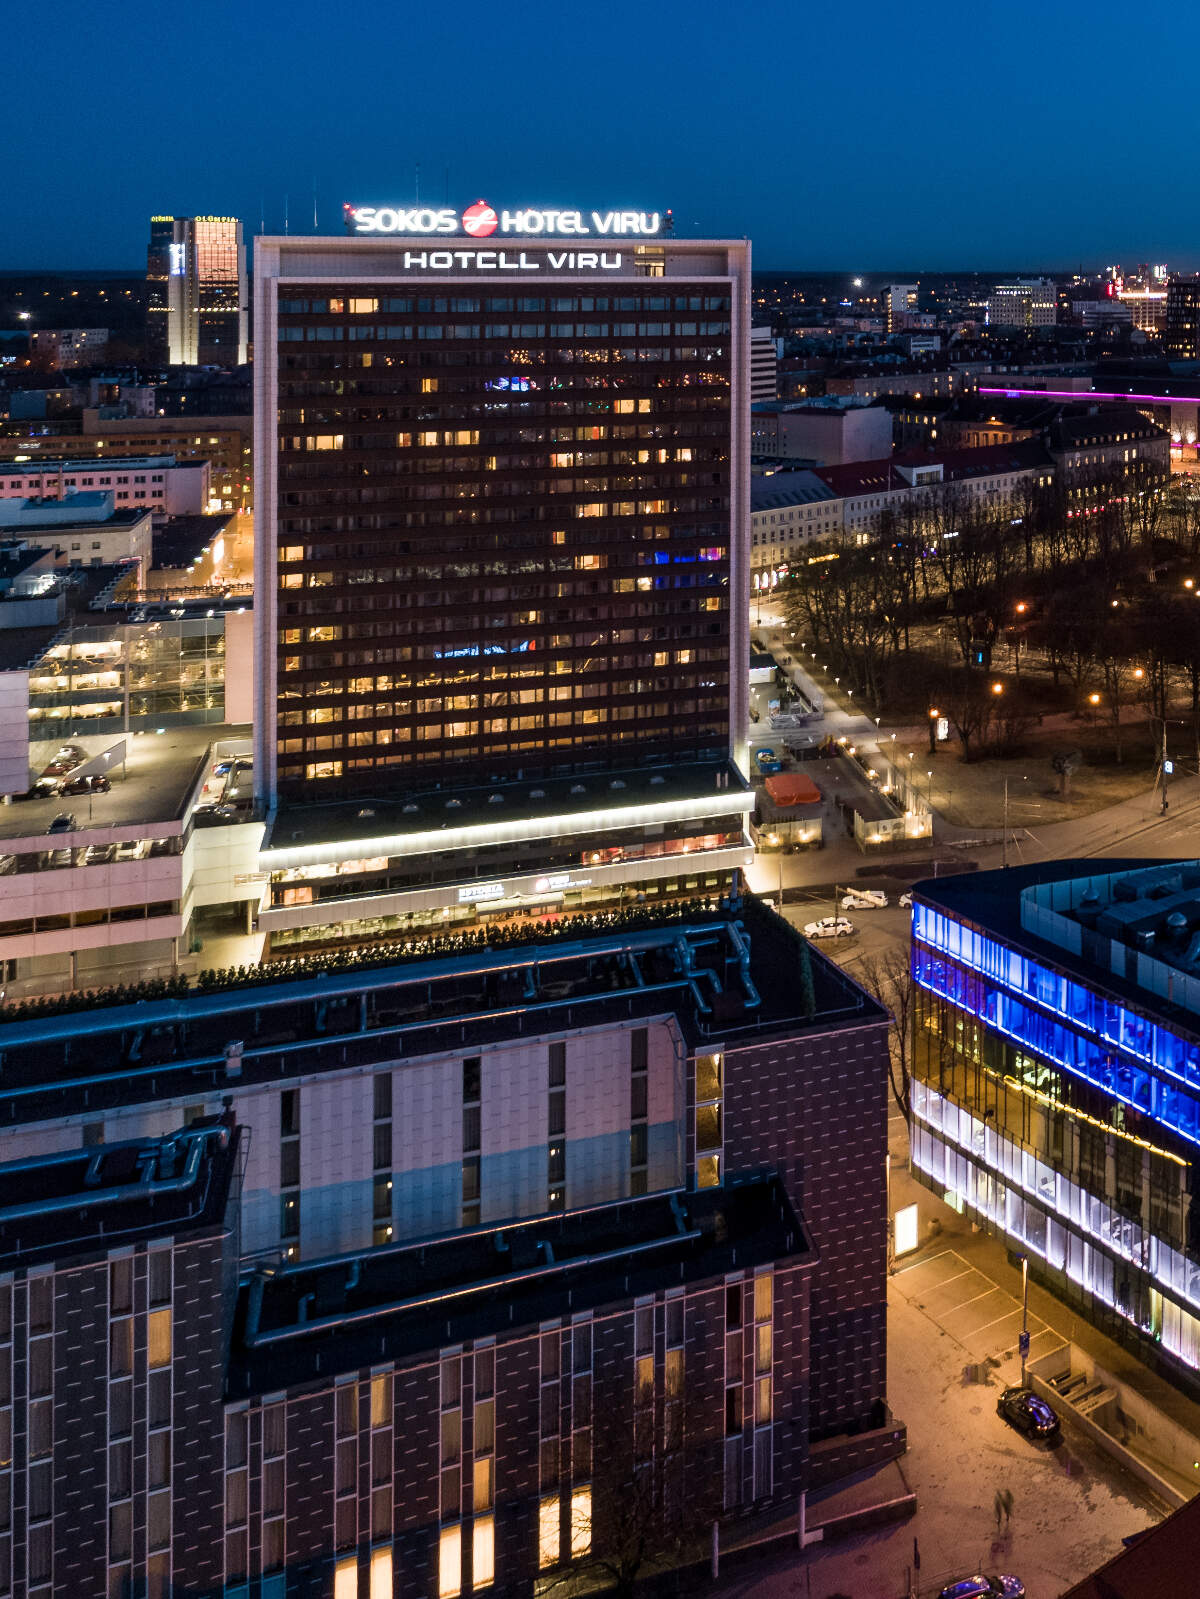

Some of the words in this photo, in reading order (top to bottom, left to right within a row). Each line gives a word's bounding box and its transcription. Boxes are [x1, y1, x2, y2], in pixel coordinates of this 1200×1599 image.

[356, 208, 458, 232] SOKOS
[502, 211, 588, 233] HOTEL
[593, 212, 660, 233] VIRU
[548, 253, 622, 268] VIRU
